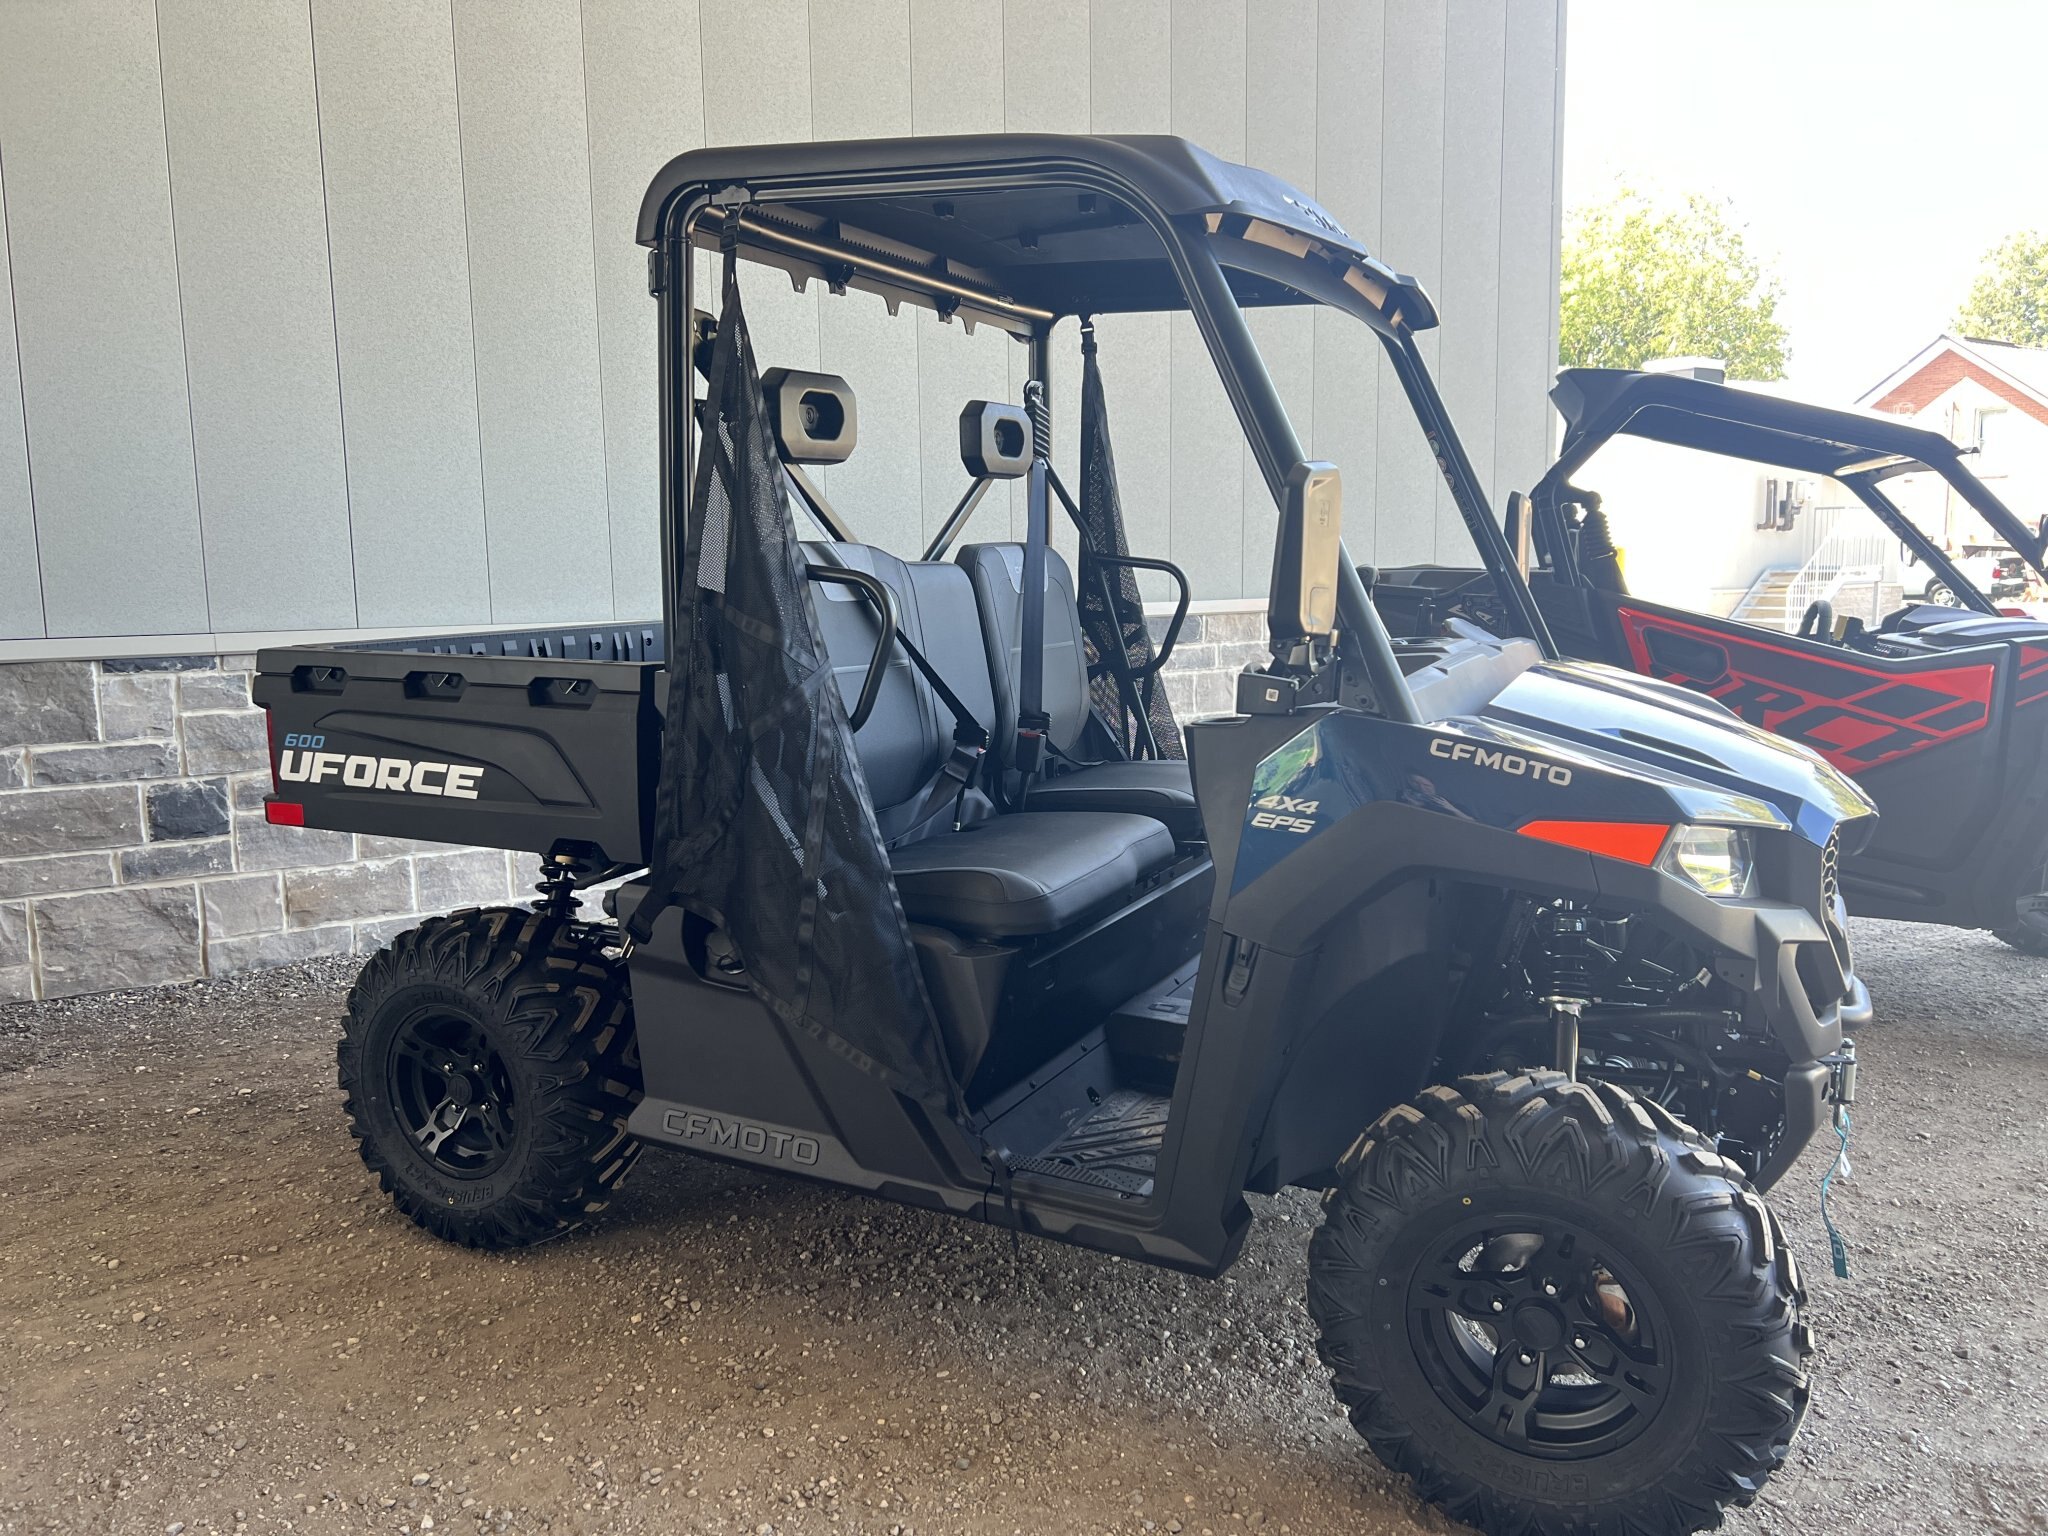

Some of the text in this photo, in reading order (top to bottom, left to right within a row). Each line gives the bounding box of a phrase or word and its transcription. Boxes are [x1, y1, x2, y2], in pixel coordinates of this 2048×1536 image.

[284, 733, 326, 749] 600
[1429, 737, 1573, 786] CFMOTO
[279, 749, 485, 800] UFORCE
[1250, 812, 1316, 834] EPS
[661, 1107, 820, 1166] CFMOTO
